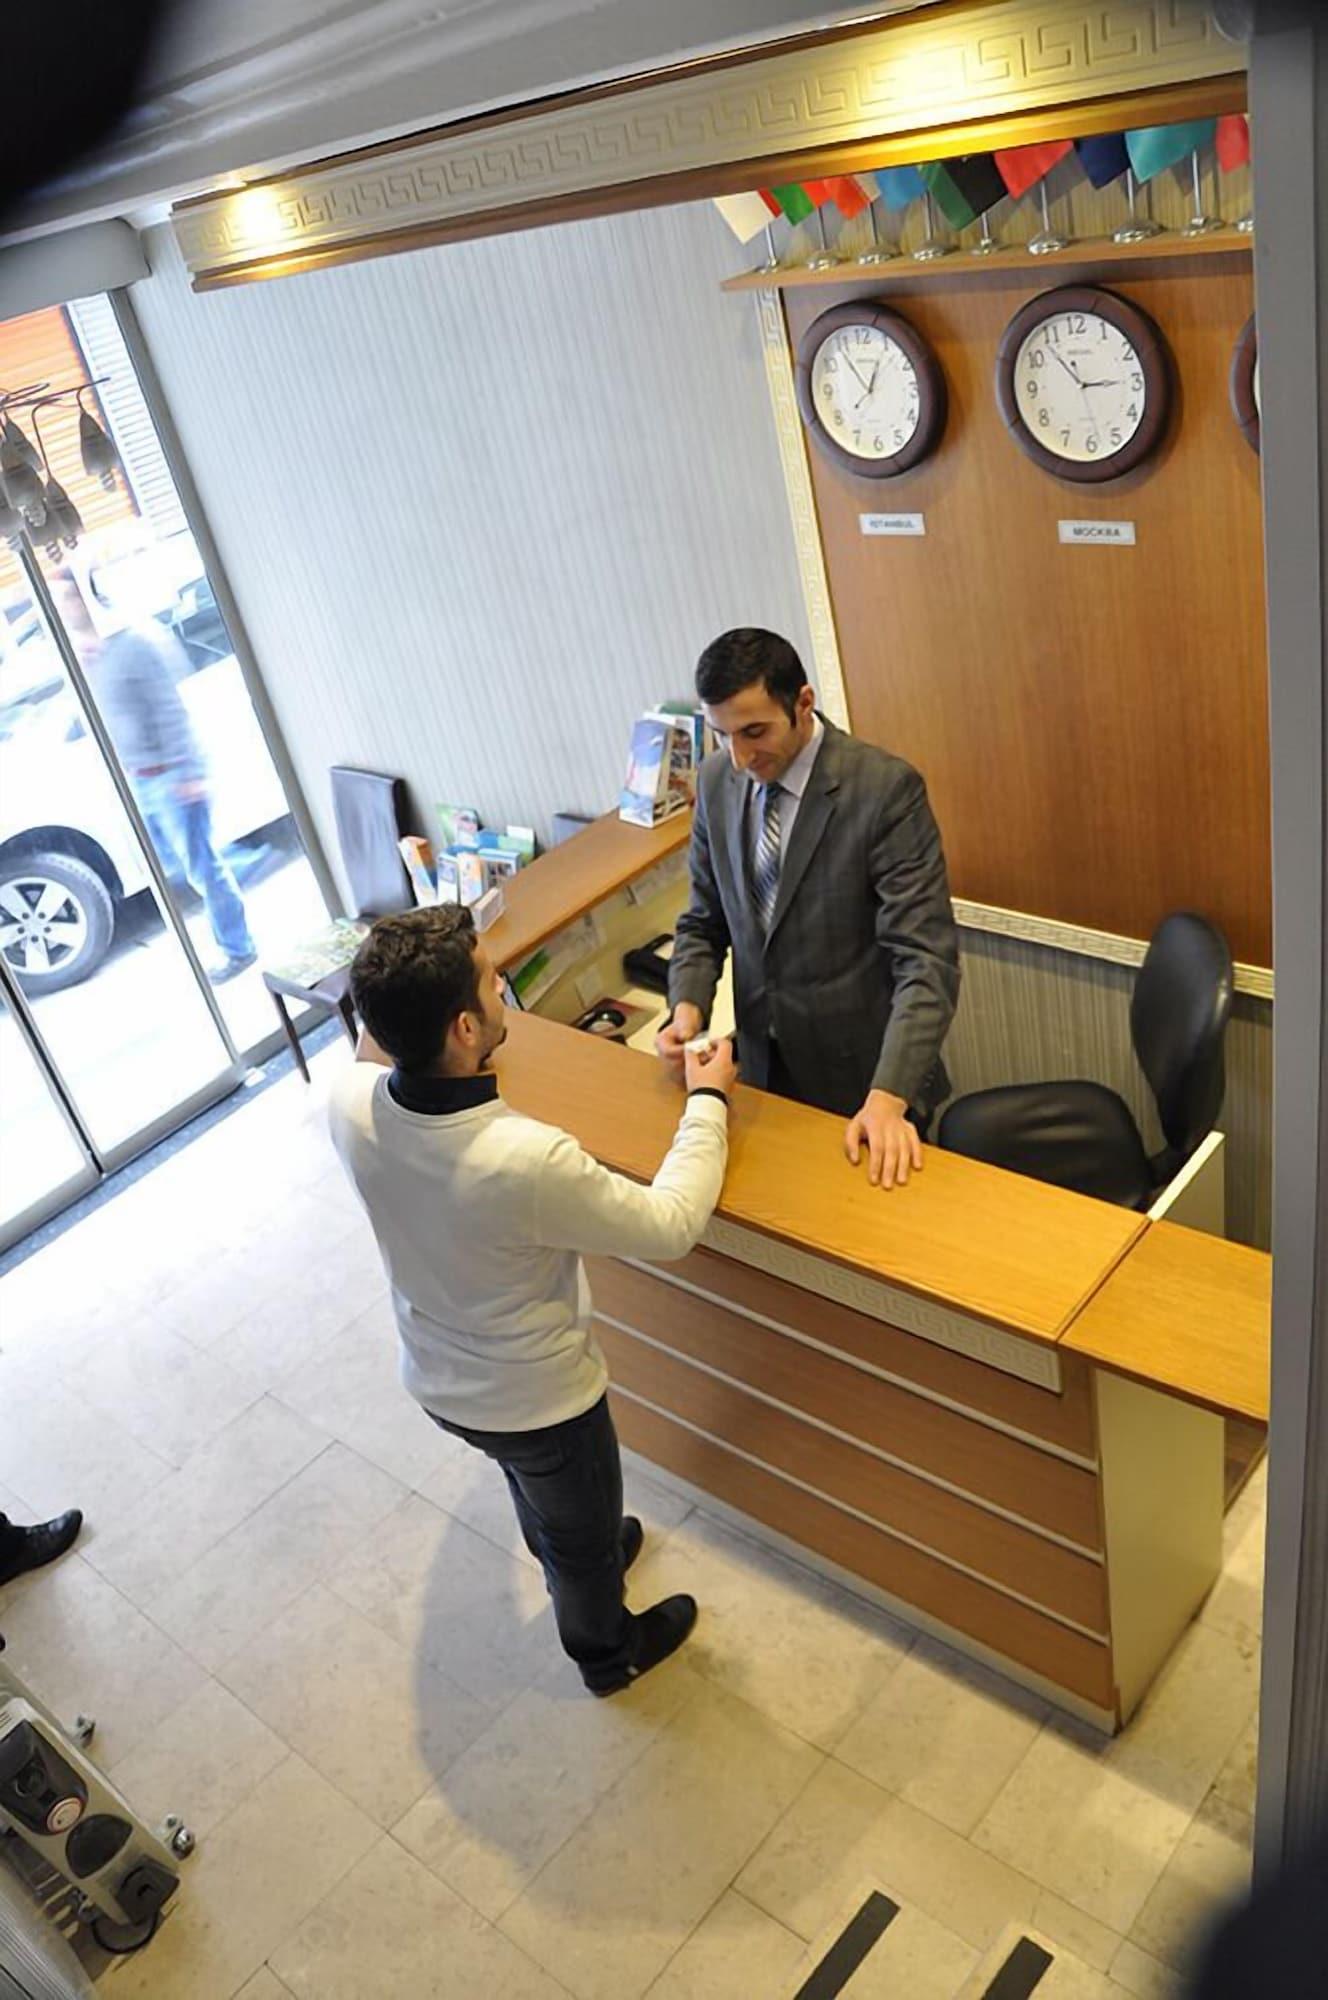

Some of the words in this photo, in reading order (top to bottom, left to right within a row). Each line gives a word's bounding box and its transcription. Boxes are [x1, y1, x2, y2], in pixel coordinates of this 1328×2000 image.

[1067, 315, 1086, 334] 12
[1100, 323, 1108, 340] 1
[855, 329, 871, 344] 12
[883, 334, 888, 351] 1
[1043, 326, 1060, 345] 11
[836, 336, 849, 352] 11
[1122, 342, 1134, 361] 2
[824, 358, 837, 373] 10
[903, 358, 911, 371] 2
[1028, 350, 1045, 368] 10
[1026, 381, 1038, 399] 9
[1131, 373, 1143, 391] 3
[823, 384, 832, 400] 9
[909, 383, 918, 398] 3
[834, 410, 843, 425] 8
[908, 409, 916, 425] 4
[1038, 409, 1050, 427] 8
[1127, 404, 1137, 422] 4
[852, 430, 861, 445] 7
[873, 436, 883, 451] 6
[894, 430, 903, 446] 5
[1061, 430, 1071, 446] 7
[1086, 435, 1097, 453] 6
[1111, 428, 1122, 446] 5
